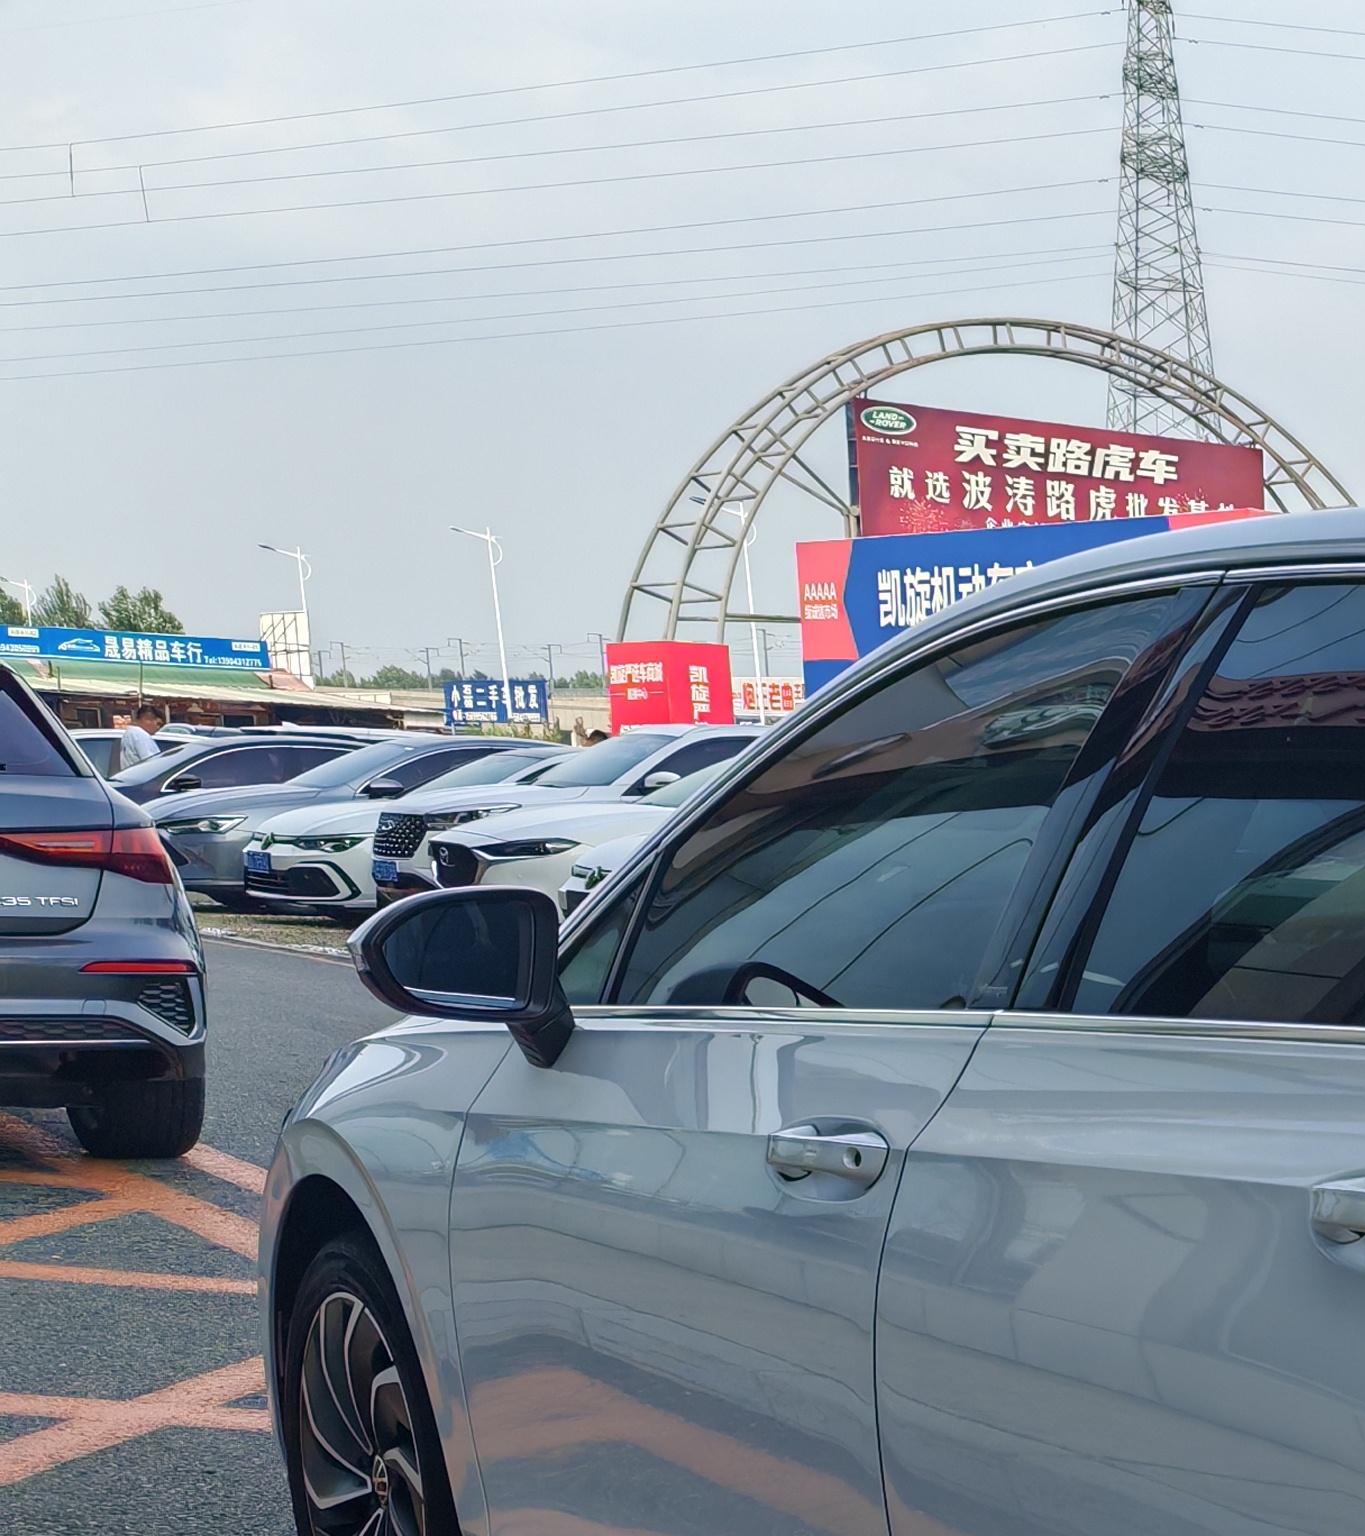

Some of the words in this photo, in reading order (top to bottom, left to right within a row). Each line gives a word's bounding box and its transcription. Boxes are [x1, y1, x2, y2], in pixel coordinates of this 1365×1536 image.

[953, 425, 1180, 485] 买卖路虎车
[804, 582, 837, 601] AAAAA
[103, 635, 203, 664] 晟易精品车行
[35, 896, 79, 906] TFSI
